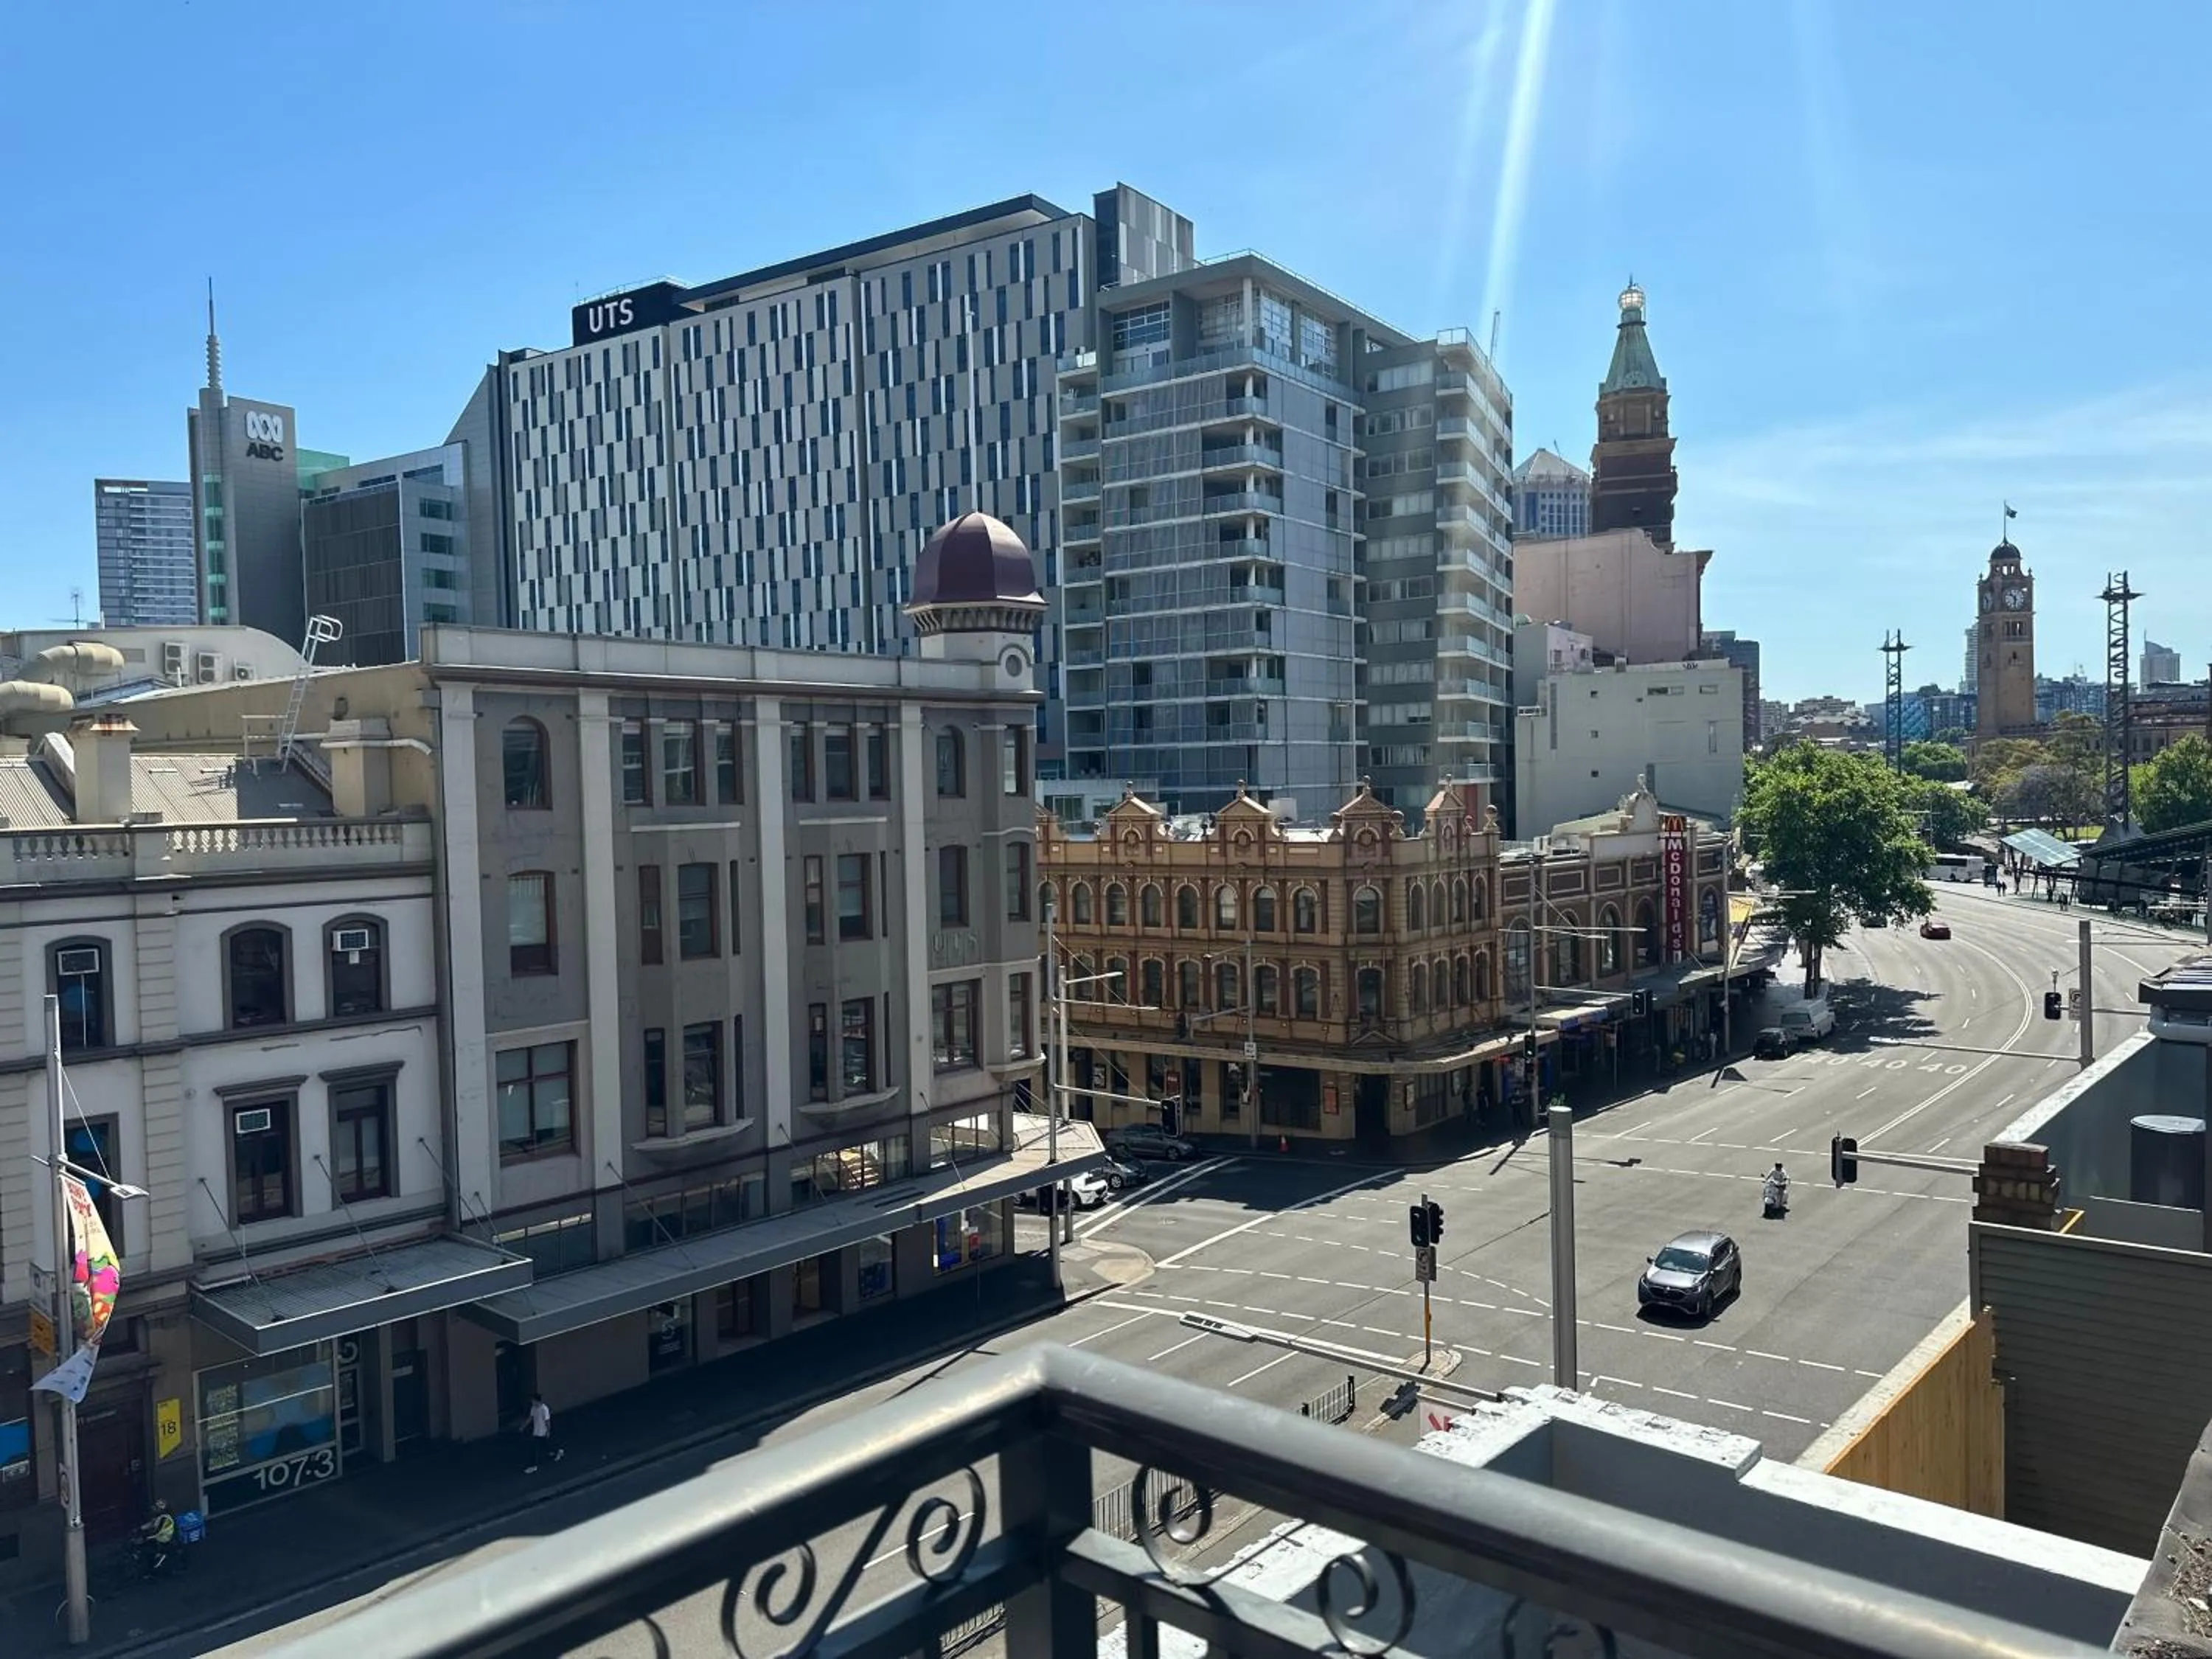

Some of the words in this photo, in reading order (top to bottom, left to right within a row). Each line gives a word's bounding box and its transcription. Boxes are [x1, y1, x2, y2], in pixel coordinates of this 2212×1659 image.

[589, 298, 634, 333] UTS
[246, 442, 283, 462] ABC
[1667, 838, 1683, 947] McDonald's
[1859, 1059, 1908, 1069] 40
[1917, 1062, 1968, 1074] 40
[160, 1421, 176, 1437] 18
[254, 1449, 334, 1490] 107.3
